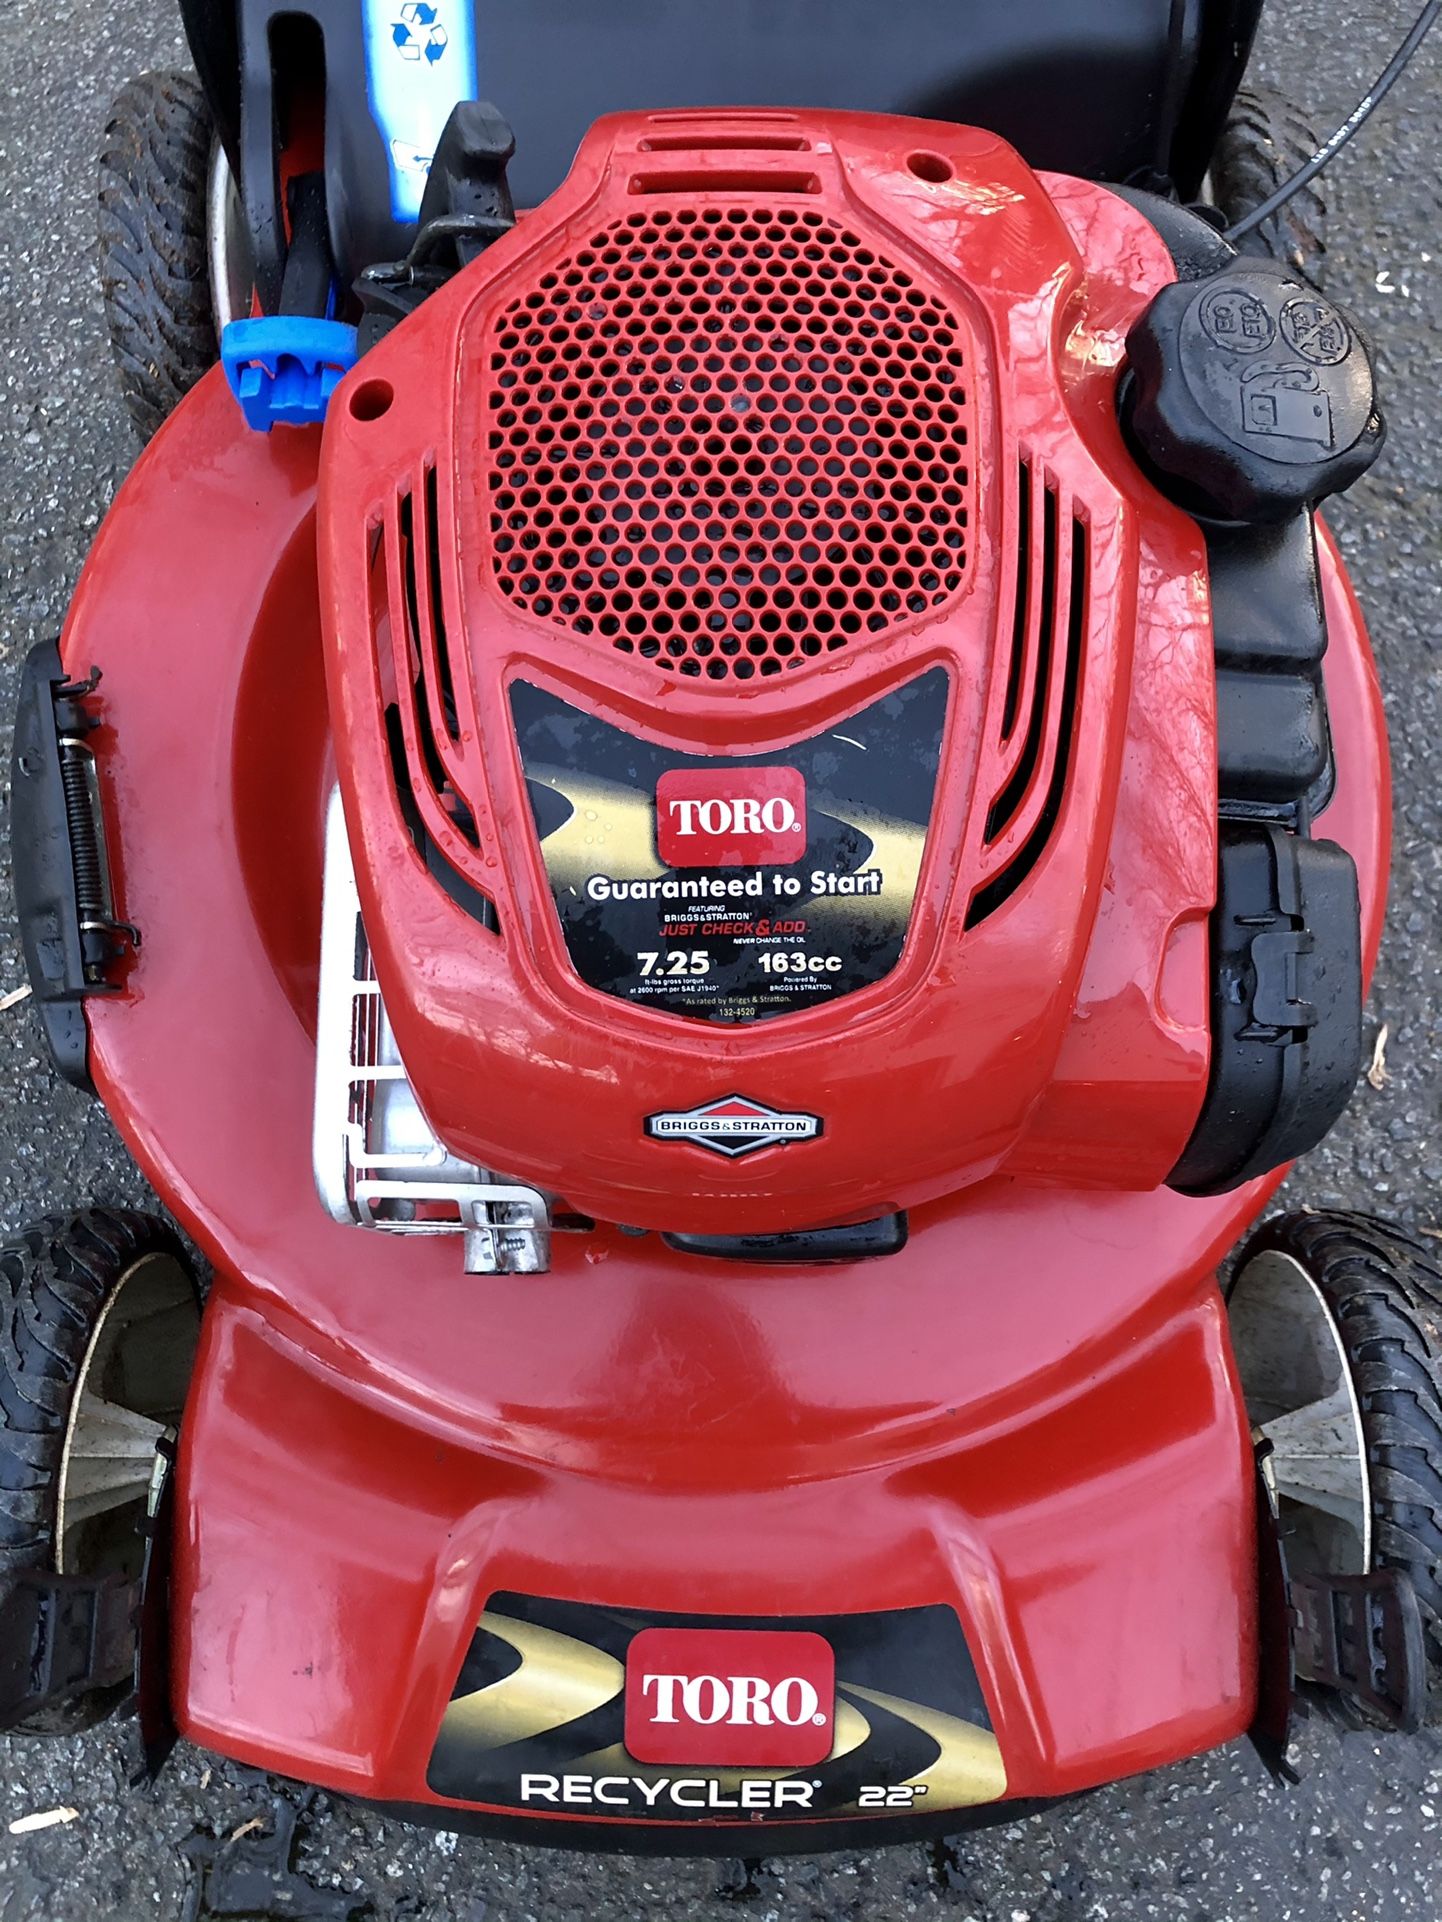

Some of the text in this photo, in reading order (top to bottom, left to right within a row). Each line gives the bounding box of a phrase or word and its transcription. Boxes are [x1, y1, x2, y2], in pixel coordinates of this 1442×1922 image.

[669, 797, 796, 836] TORO
[587, 868, 880, 900] Guaranteed to Start
[687, 904, 726, 913] FEATURING
[658, 919, 807, 937] JUST CHECK & ADD
[733, 937, 756, 945] NEVER
[783, 936, 796, 944] THE
[636, 950, 710, 976] 7.25
[758, 952, 842, 973] 163cc
[682, 978, 705, 986] torque
[769, 984, 793, 992] BRIGGS
[637, 986, 654, 994] 2600
[654, 987, 668, 995] rpm
[718, 997, 727, 1005] by
[728, 996, 751, 1005] Briggs
[751, 995, 758, 1003] &
[719, 1007, 755, 1017] 132-4520
[641, 1673, 819, 1727] TORO
[520, 1773, 929, 1809] RECYCLER 22"
